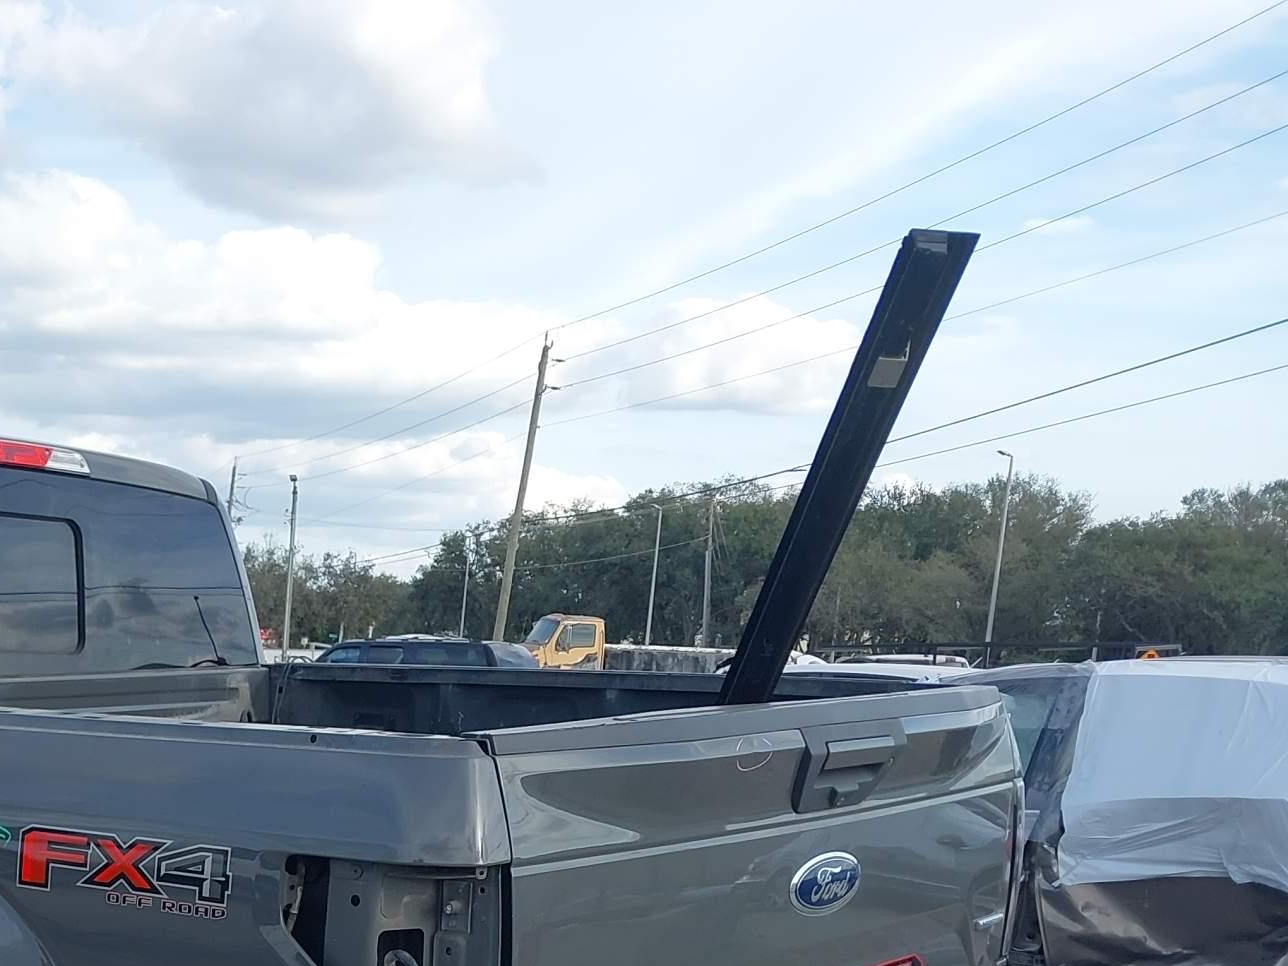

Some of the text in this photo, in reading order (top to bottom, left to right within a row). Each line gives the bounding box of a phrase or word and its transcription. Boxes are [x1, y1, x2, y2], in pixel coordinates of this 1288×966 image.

[17, 824, 231, 907] FX4
[811, 866, 851, 902] Ford
[106, 891, 227, 920] OFF ROAD
